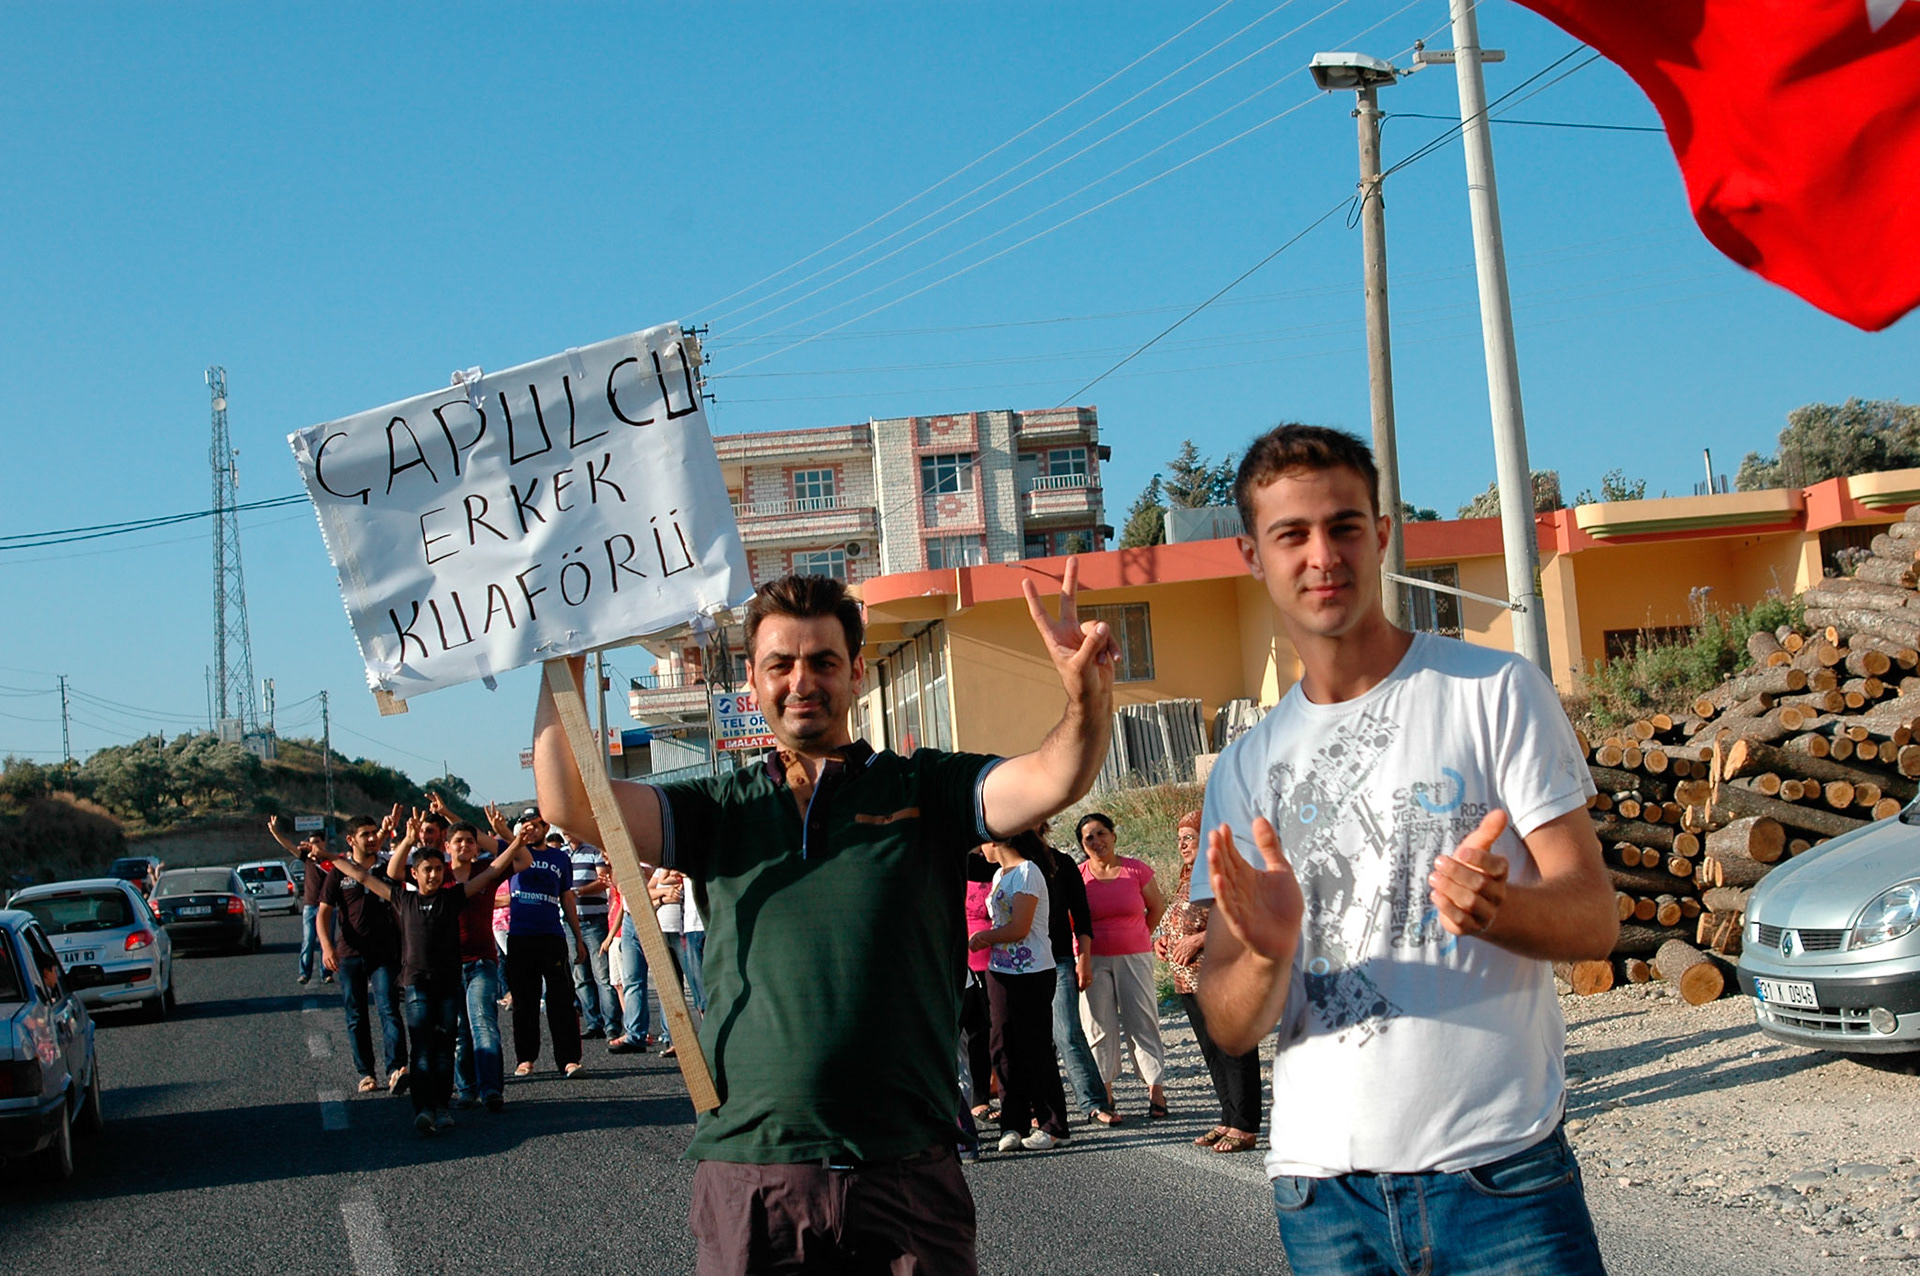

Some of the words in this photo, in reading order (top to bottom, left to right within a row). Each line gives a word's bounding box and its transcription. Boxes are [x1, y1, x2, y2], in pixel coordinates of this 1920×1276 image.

[420, 453, 627, 565] ERKEK
[388, 509, 695, 663] KUAFÖRÜ
[721, 718, 745, 728] TEL
[1760, 982, 1773, 1001] 31
[1788, 985, 1813, 1004] 0946
